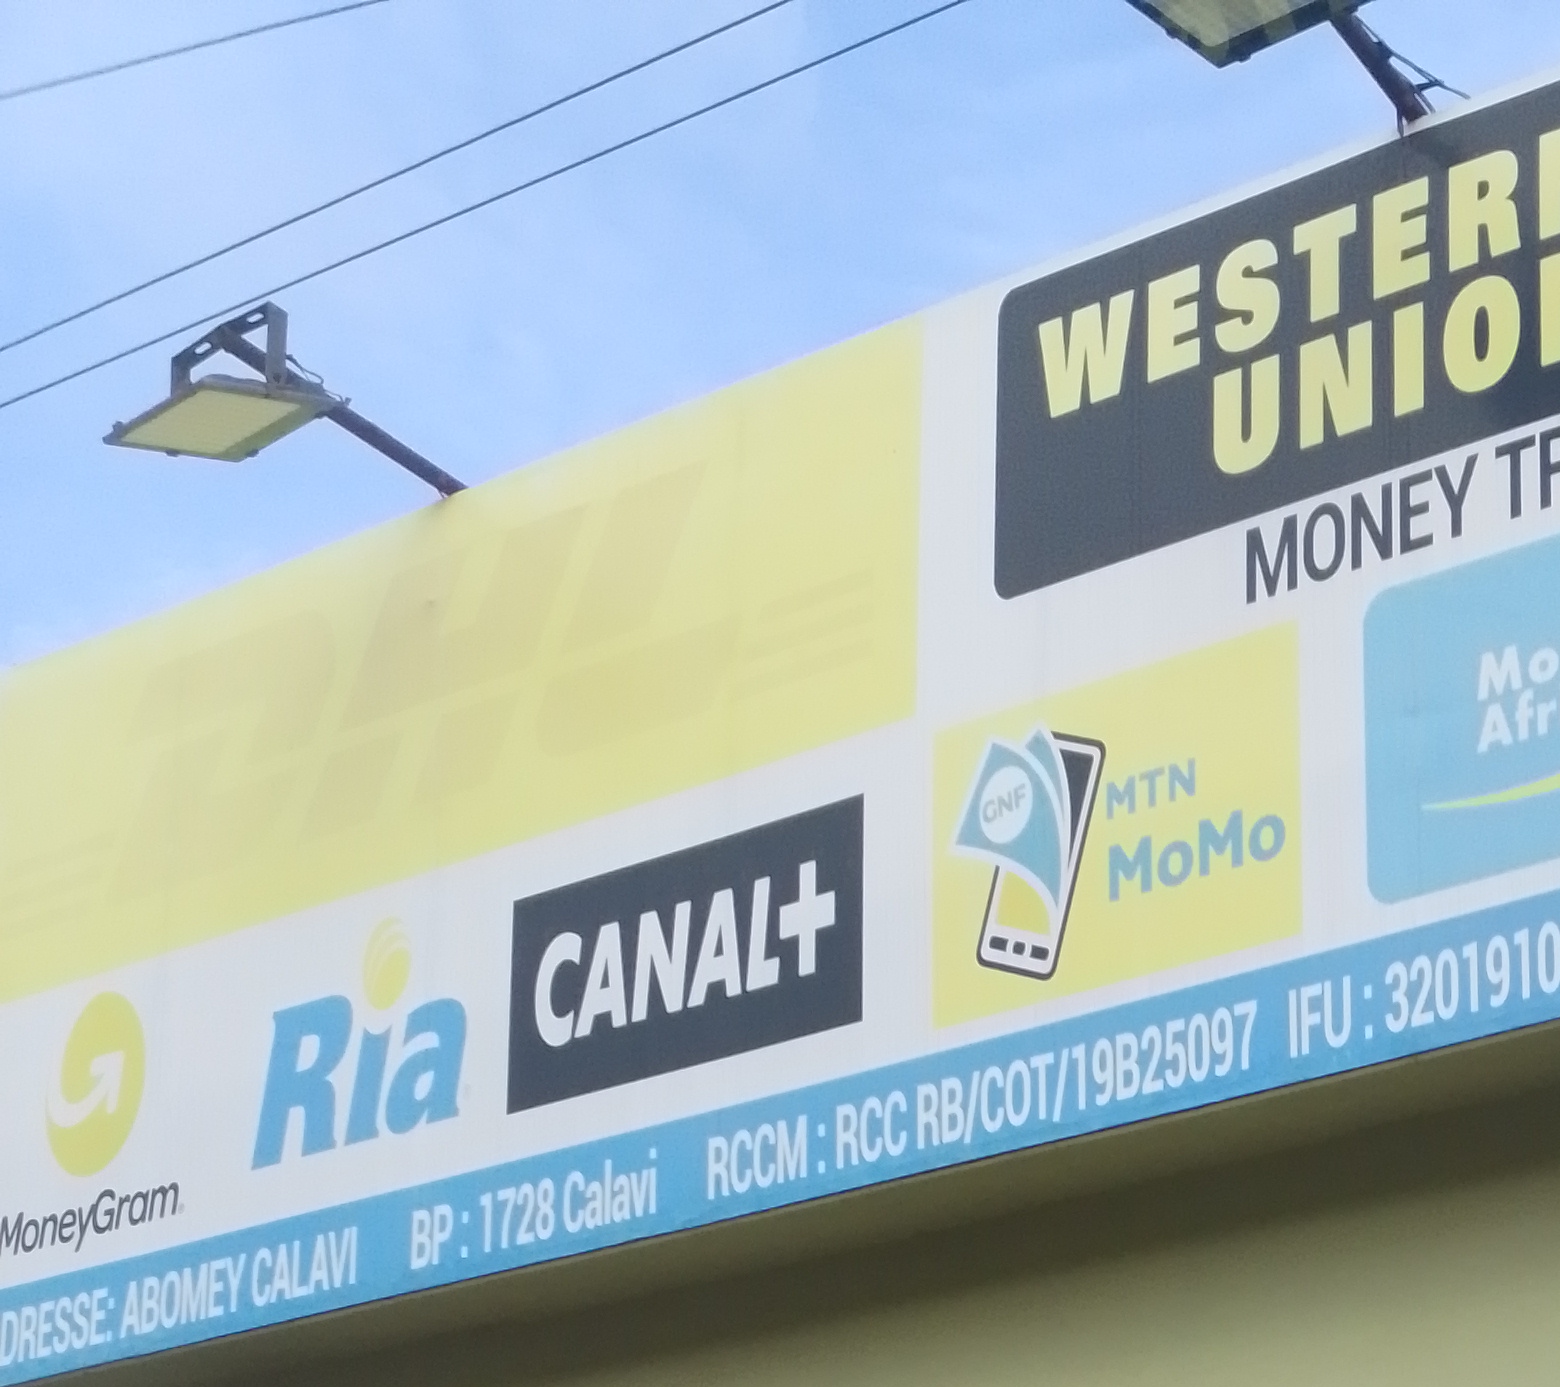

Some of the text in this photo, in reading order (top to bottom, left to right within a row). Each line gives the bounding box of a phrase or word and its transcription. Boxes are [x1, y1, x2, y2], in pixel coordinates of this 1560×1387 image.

[1245, 454, 1478, 604] MONEY
[982, 783, 1028, 825] GNF
[1106, 757, 1197, 820] MTN
[1107, 809, 1286, 902] MoMo
[534, 860, 836, 1048] CANAL+
[251, 917, 467, 1171] Ria
[0, 1182, 180, 1256] MoneyGram
[120, 1253, 246, 1340] ABOMEY
[251, 1226, 358, 1307] CALAVI
[480, 1177, 555, 1253] 1728
[562, 1147, 657, 1234] Calavi
[835, 1091, 907, 1169] RCC
